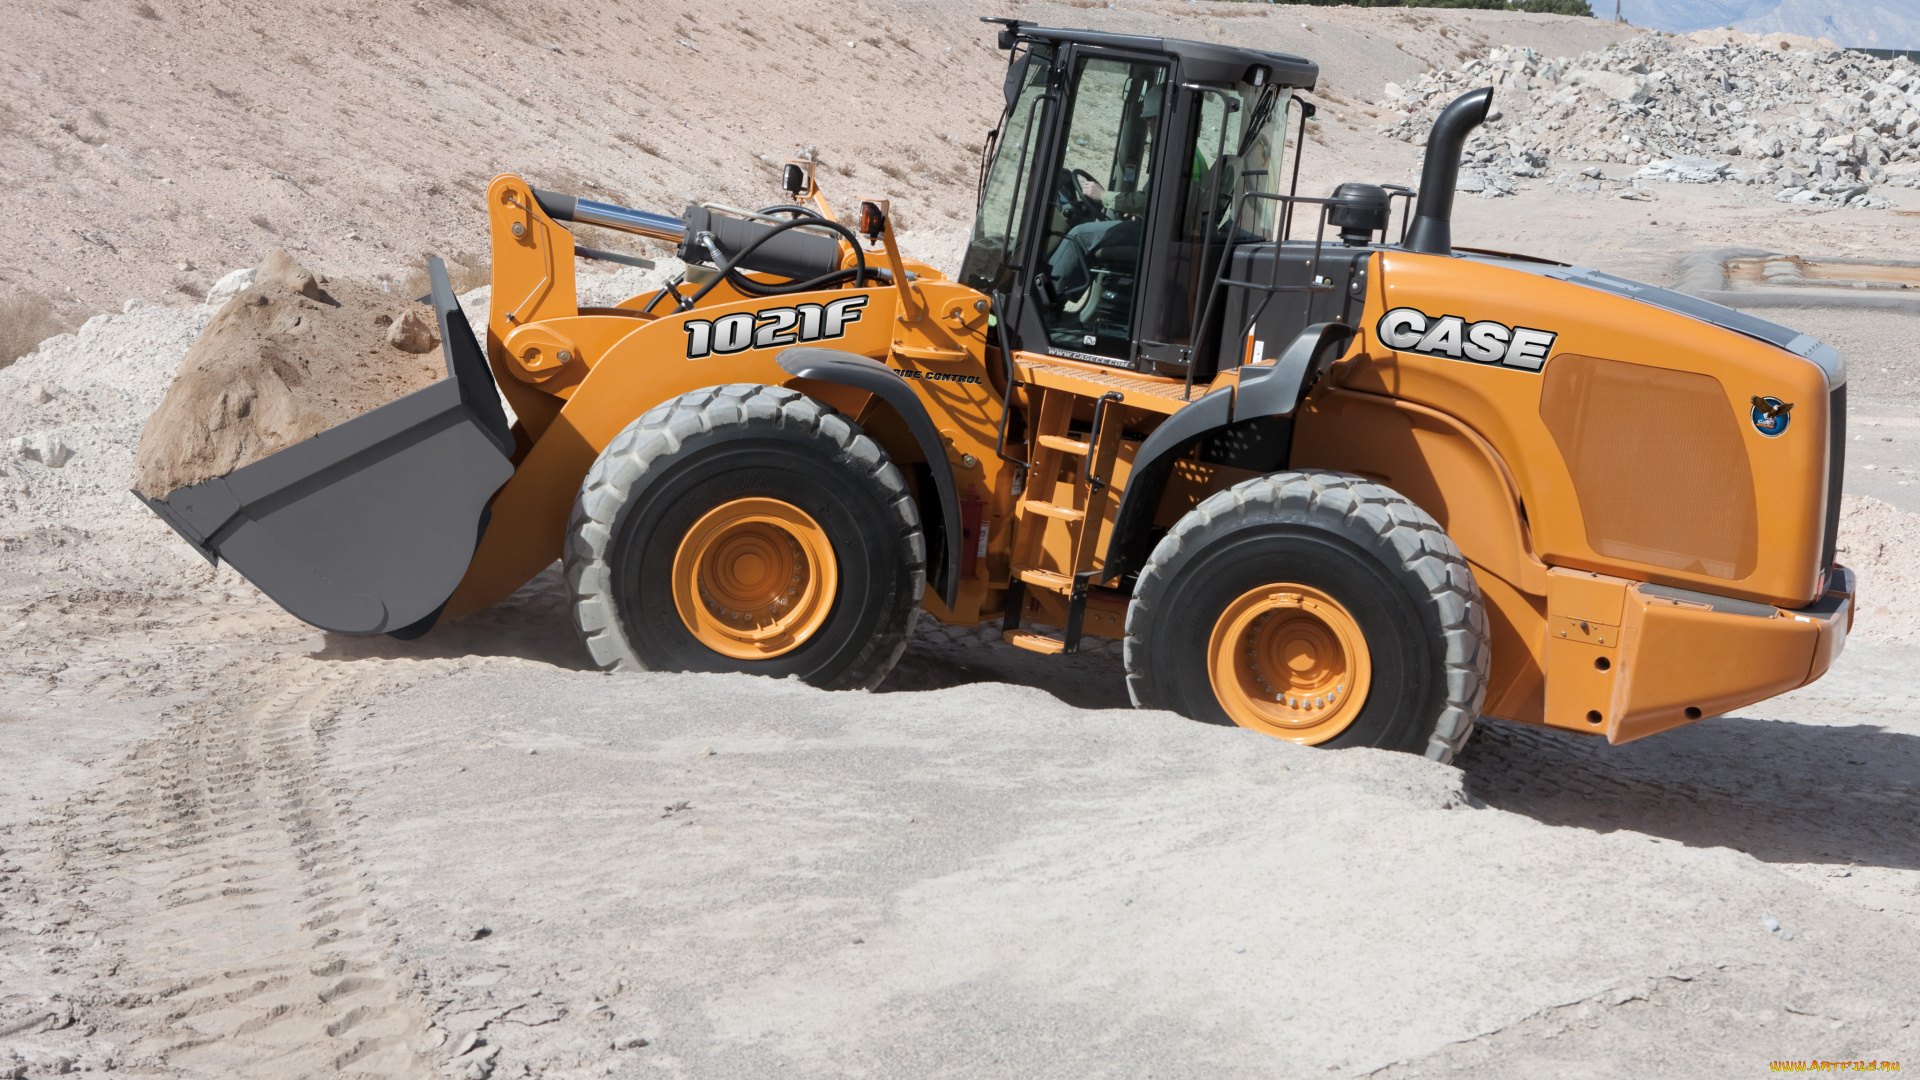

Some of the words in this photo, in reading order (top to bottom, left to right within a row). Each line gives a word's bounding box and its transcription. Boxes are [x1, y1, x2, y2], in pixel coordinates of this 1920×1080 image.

[684, 294, 869, 359] 1021F
[1377, 307, 1557, 374] CASE
[925, 371, 982, 385] CONTROL
[1048, 348, 1129, 368] WWW.CASECE.COM
